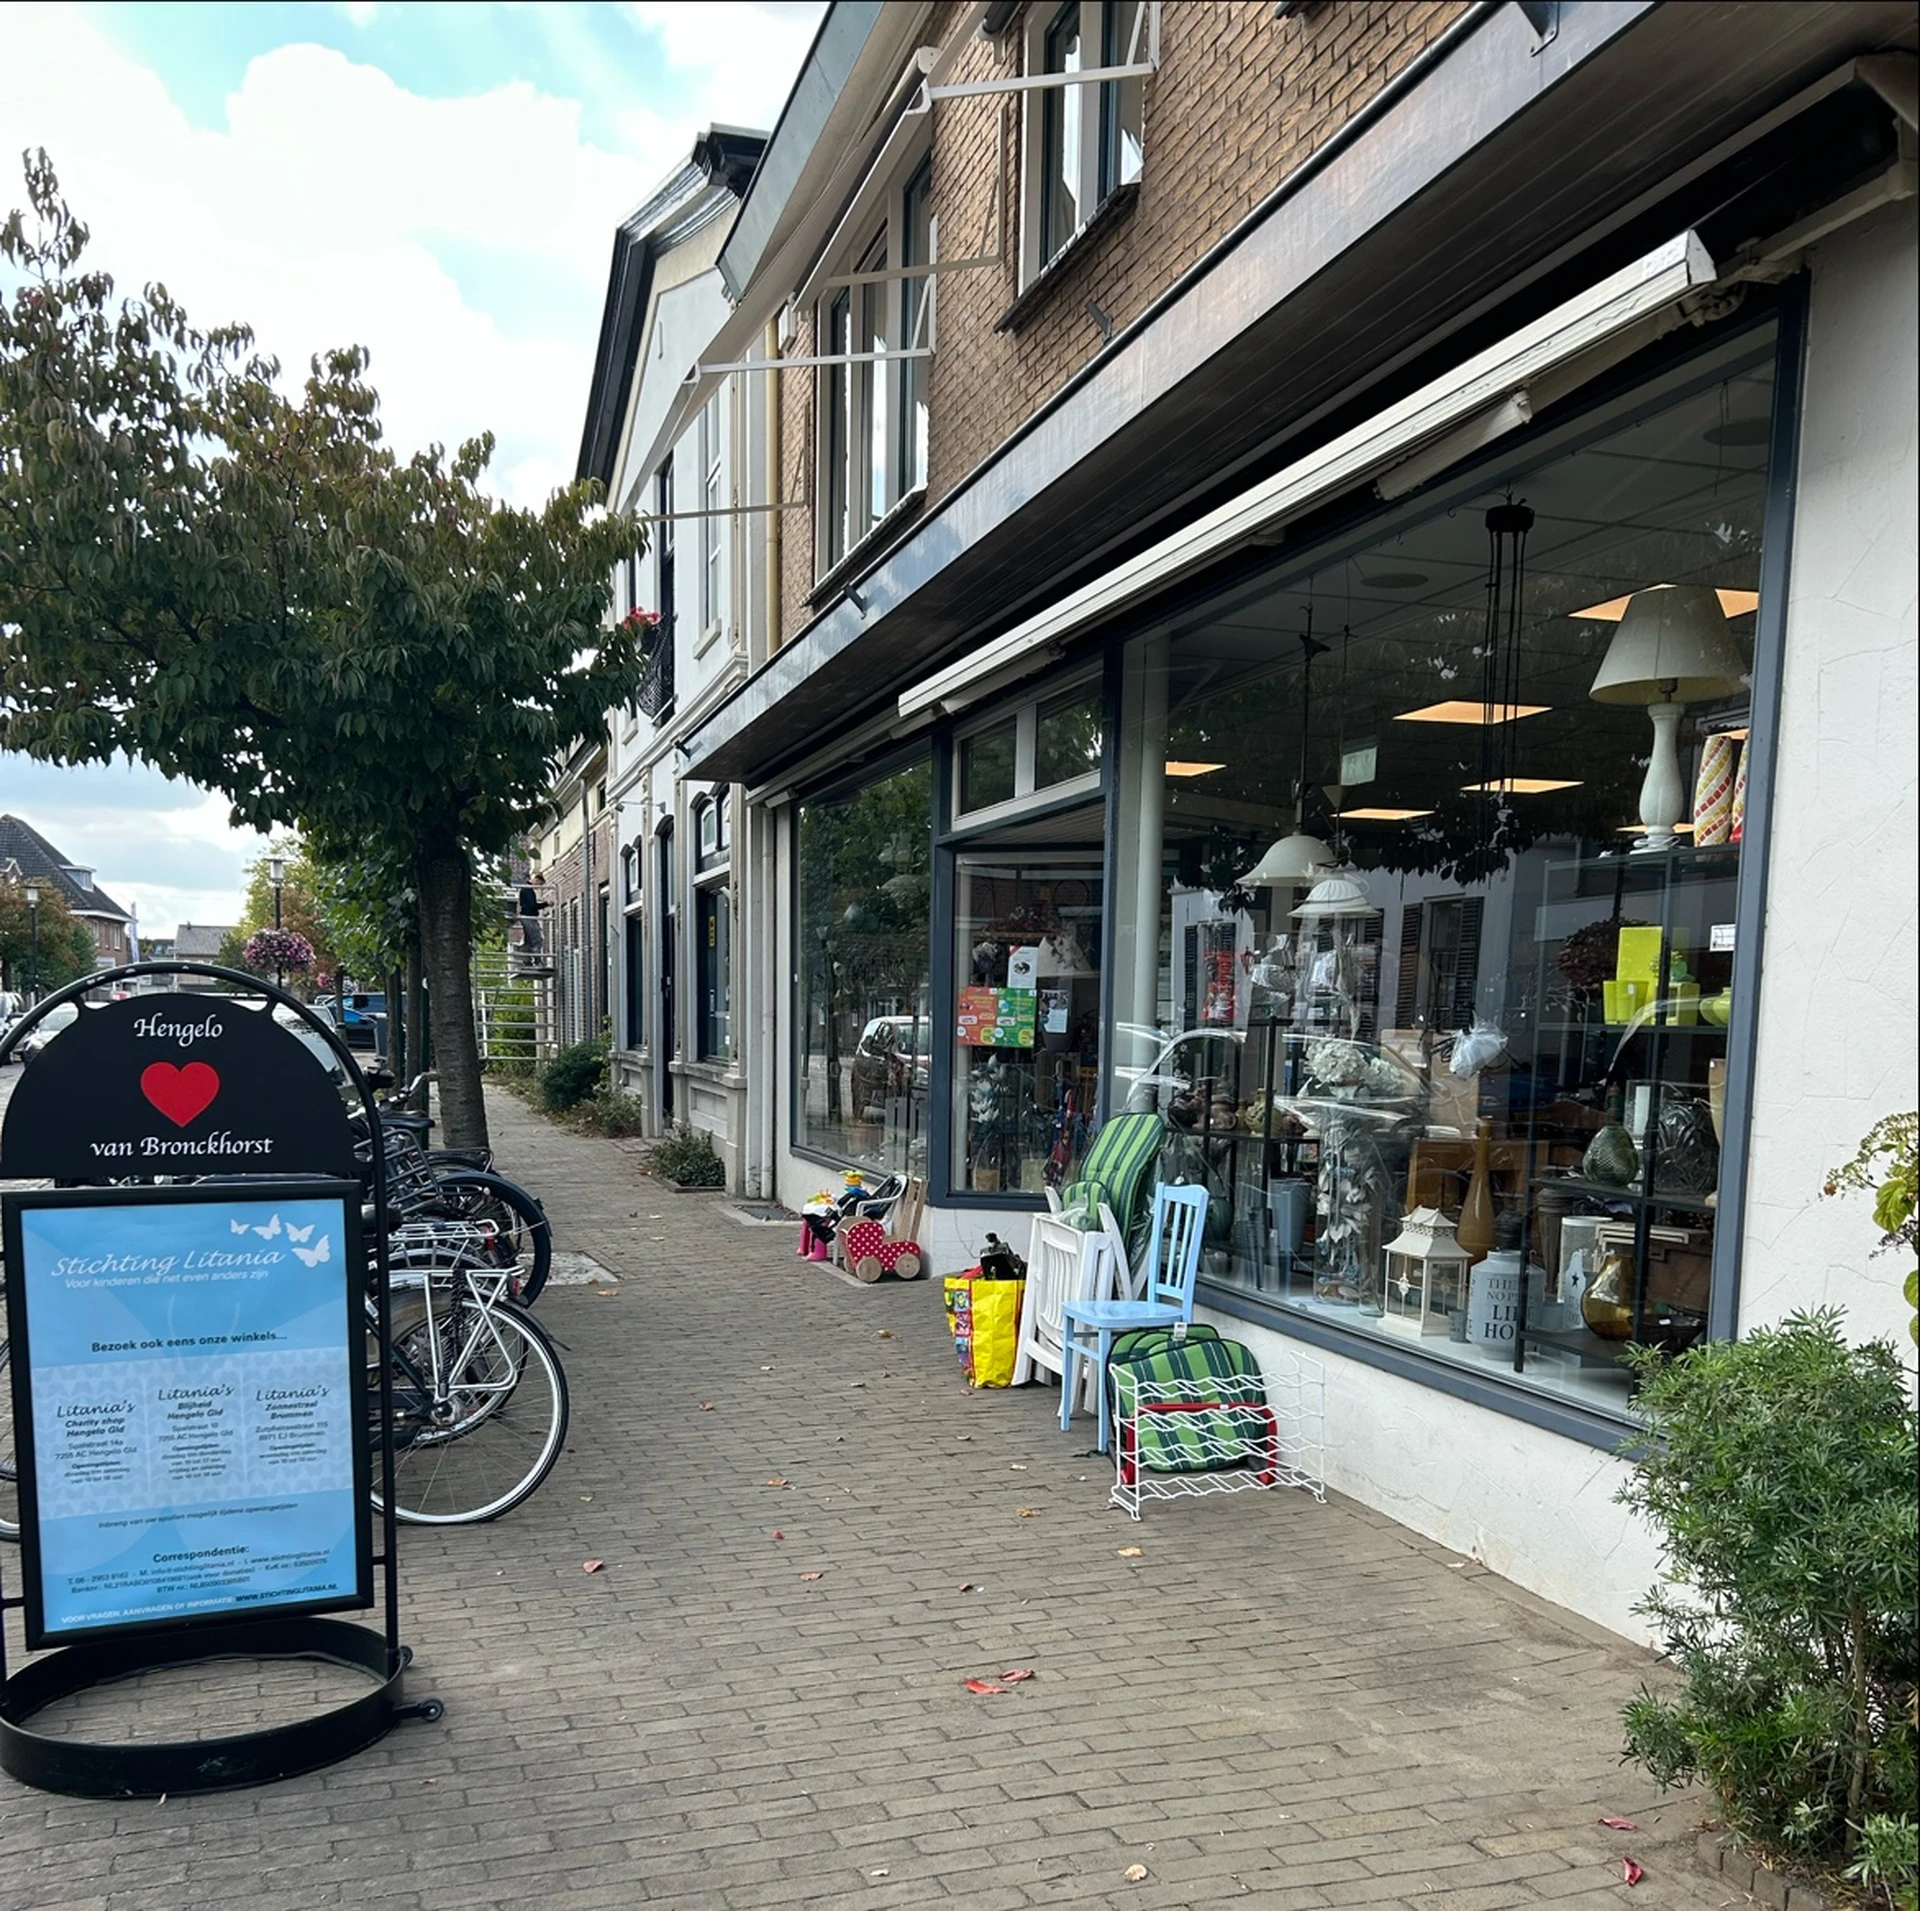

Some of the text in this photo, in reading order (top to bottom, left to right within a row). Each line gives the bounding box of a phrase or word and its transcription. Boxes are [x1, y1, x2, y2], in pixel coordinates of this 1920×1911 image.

[134, 1012, 223, 1047] Hengelo
[90, 1131, 274, 1157] van Bronckhorst
[52, 1249, 286, 1276] Stichting Litania
[65, 1279, 91, 1289] Voor
[93, 1276, 141, 1288] kinderen
[143, 1275, 160, 1285] die
[183, 1273, 209, 1282] even
[211, 1270, 247, 1281] anders
[250, 1269, 269, 1280] zijn
[1484, 1322, 1514, 1340] HO
[92, 1341, 137, 1352] Bezoek
[141, 1338, 164, 1349] ook
[167, 1337, 195, 1347] eens
[199, 1336, 228, 1345] onze
[158, 1384, 235, 1401] Litania's
[256, 1385, 330, 1401] Litania's
[57, 1400, 136, 1418] Litania's
[67, 1426, 125, 1438] Hengelo Gld
[153, 1546, 250, 1563] Correspondentie:
